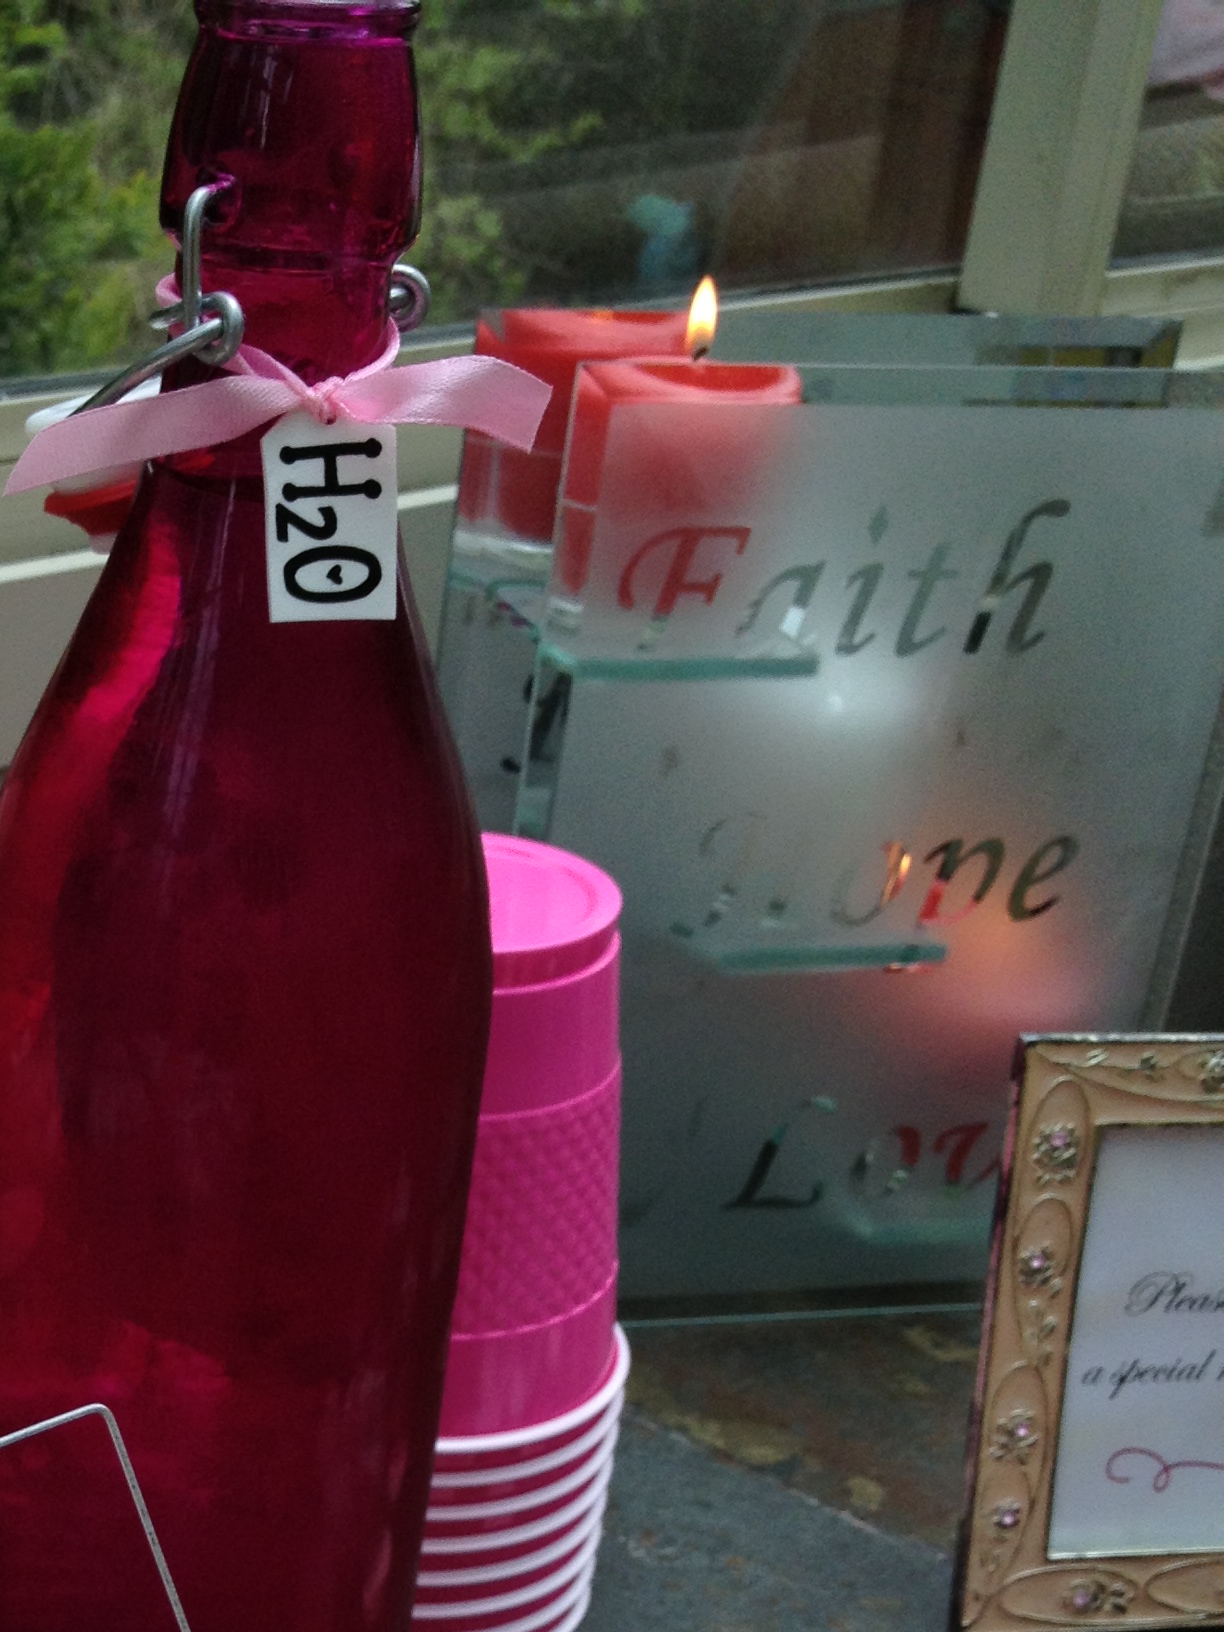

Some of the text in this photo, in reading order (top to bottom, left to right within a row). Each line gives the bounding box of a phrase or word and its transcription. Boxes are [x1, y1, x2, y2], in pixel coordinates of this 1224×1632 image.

[276, 437, 382, 604] H2O
[617, 498, 1071, 658] Faith
[1080, 1366, 1104, 1386] a
[1108, 1349, 1217, 1401] special
